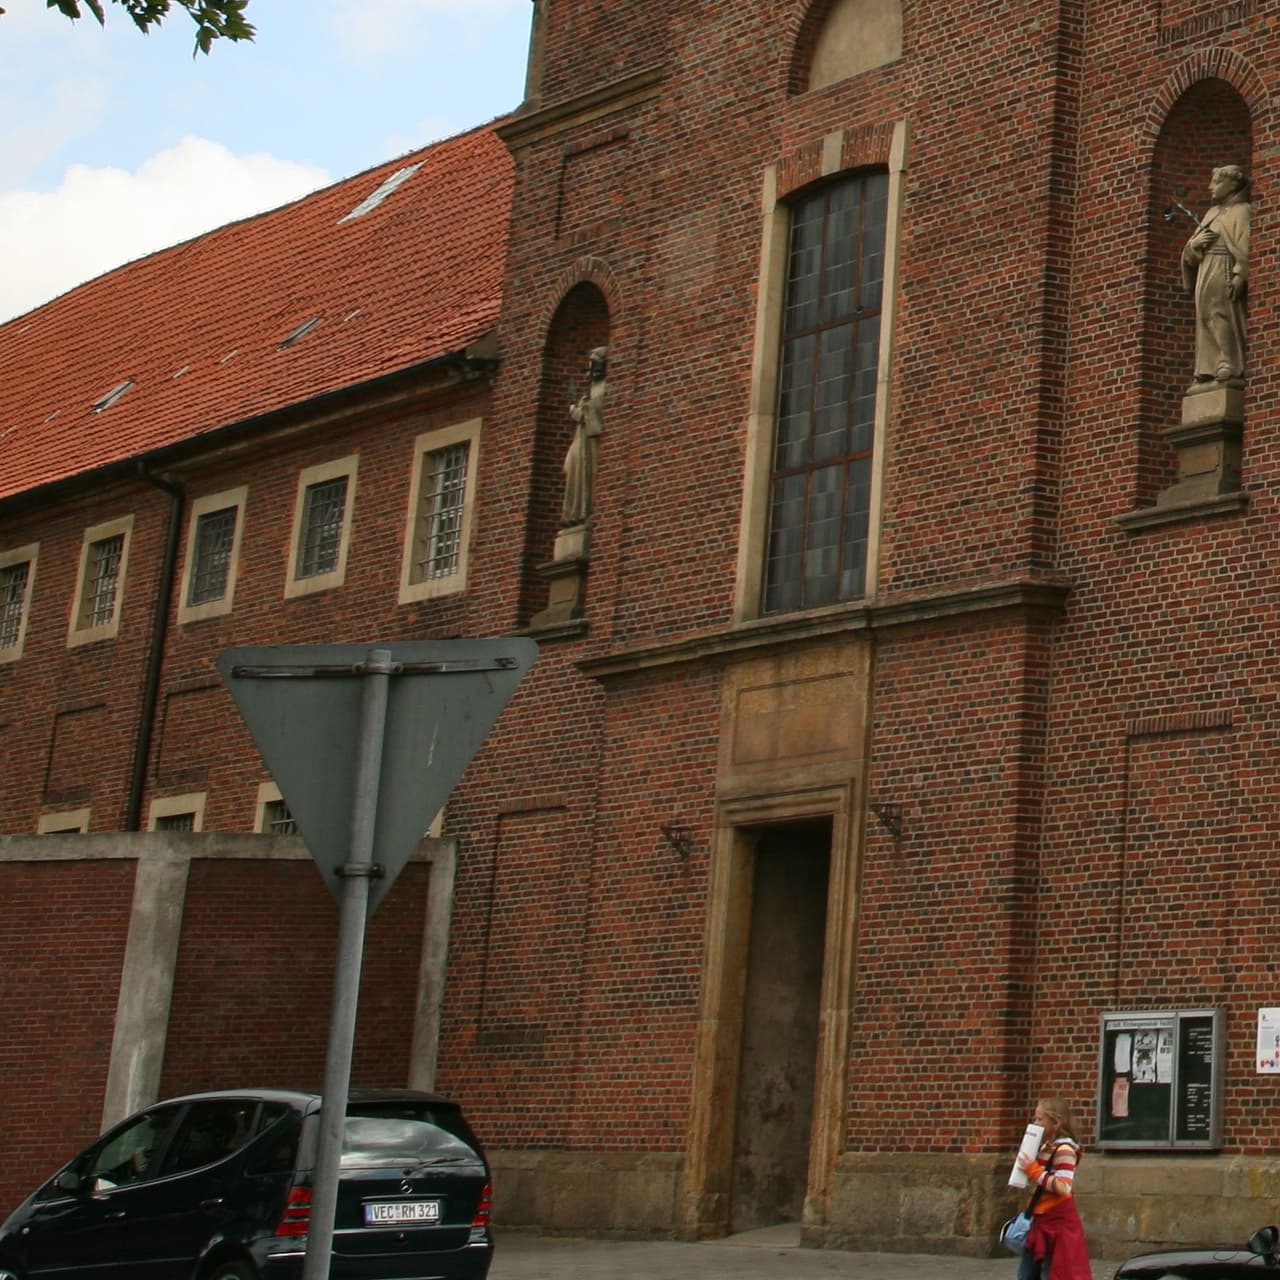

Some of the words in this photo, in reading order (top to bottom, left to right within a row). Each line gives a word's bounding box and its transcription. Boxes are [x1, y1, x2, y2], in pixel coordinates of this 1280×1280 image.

[374, 1205, 394, 1219] VEC
[402, 1205, 416, 1218] RM
[418, 1204, 437, 1218] 321
